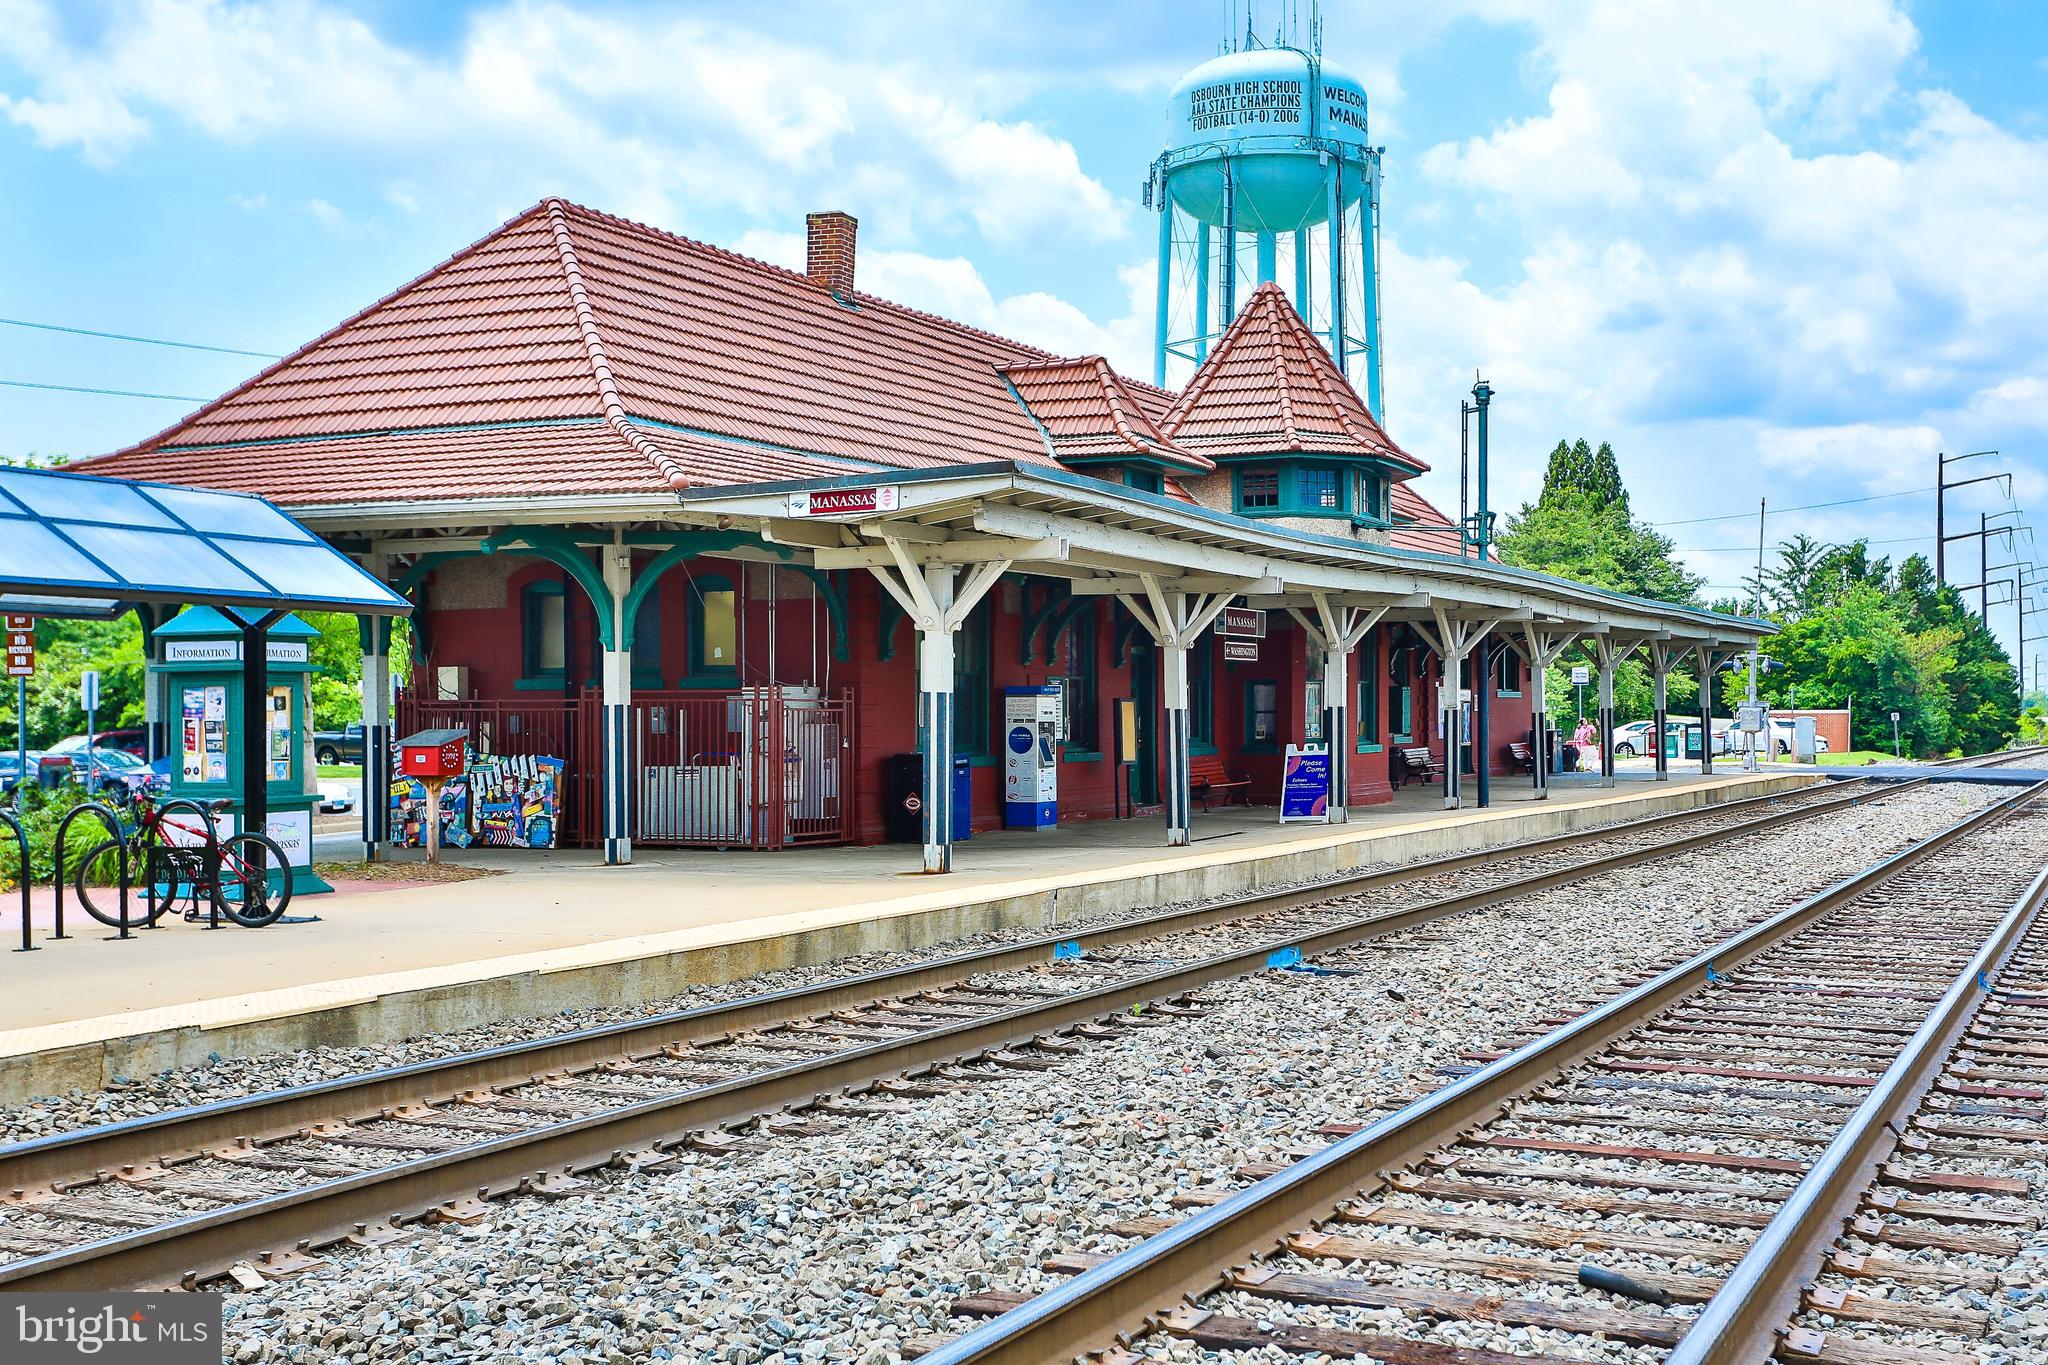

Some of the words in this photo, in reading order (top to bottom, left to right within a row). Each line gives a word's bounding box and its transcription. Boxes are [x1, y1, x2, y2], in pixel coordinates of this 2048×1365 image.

[1191, 83, 1231, 104] OSBOURN
[1234, 80, 1259, 95] HIGH
[1263, 80, 1302, 94] SCHOOL
[1191, 102, 1206, 117] AAA
[1209, 97, 1237, 113] STATE
[1240, 94, 1301, 109] CHAMPIONS
[1193, 111, 1236, 132] FOOTBALL
[1239, 110, 1270, 124] (14-0)
[1273, 110, 1299, 123] 2006
[810, 493, 876, 509] MANASSAS
[1227, 616, 1256, 629] MANASSAS
[1230, 646, 1256, 657] WASHINGTON
